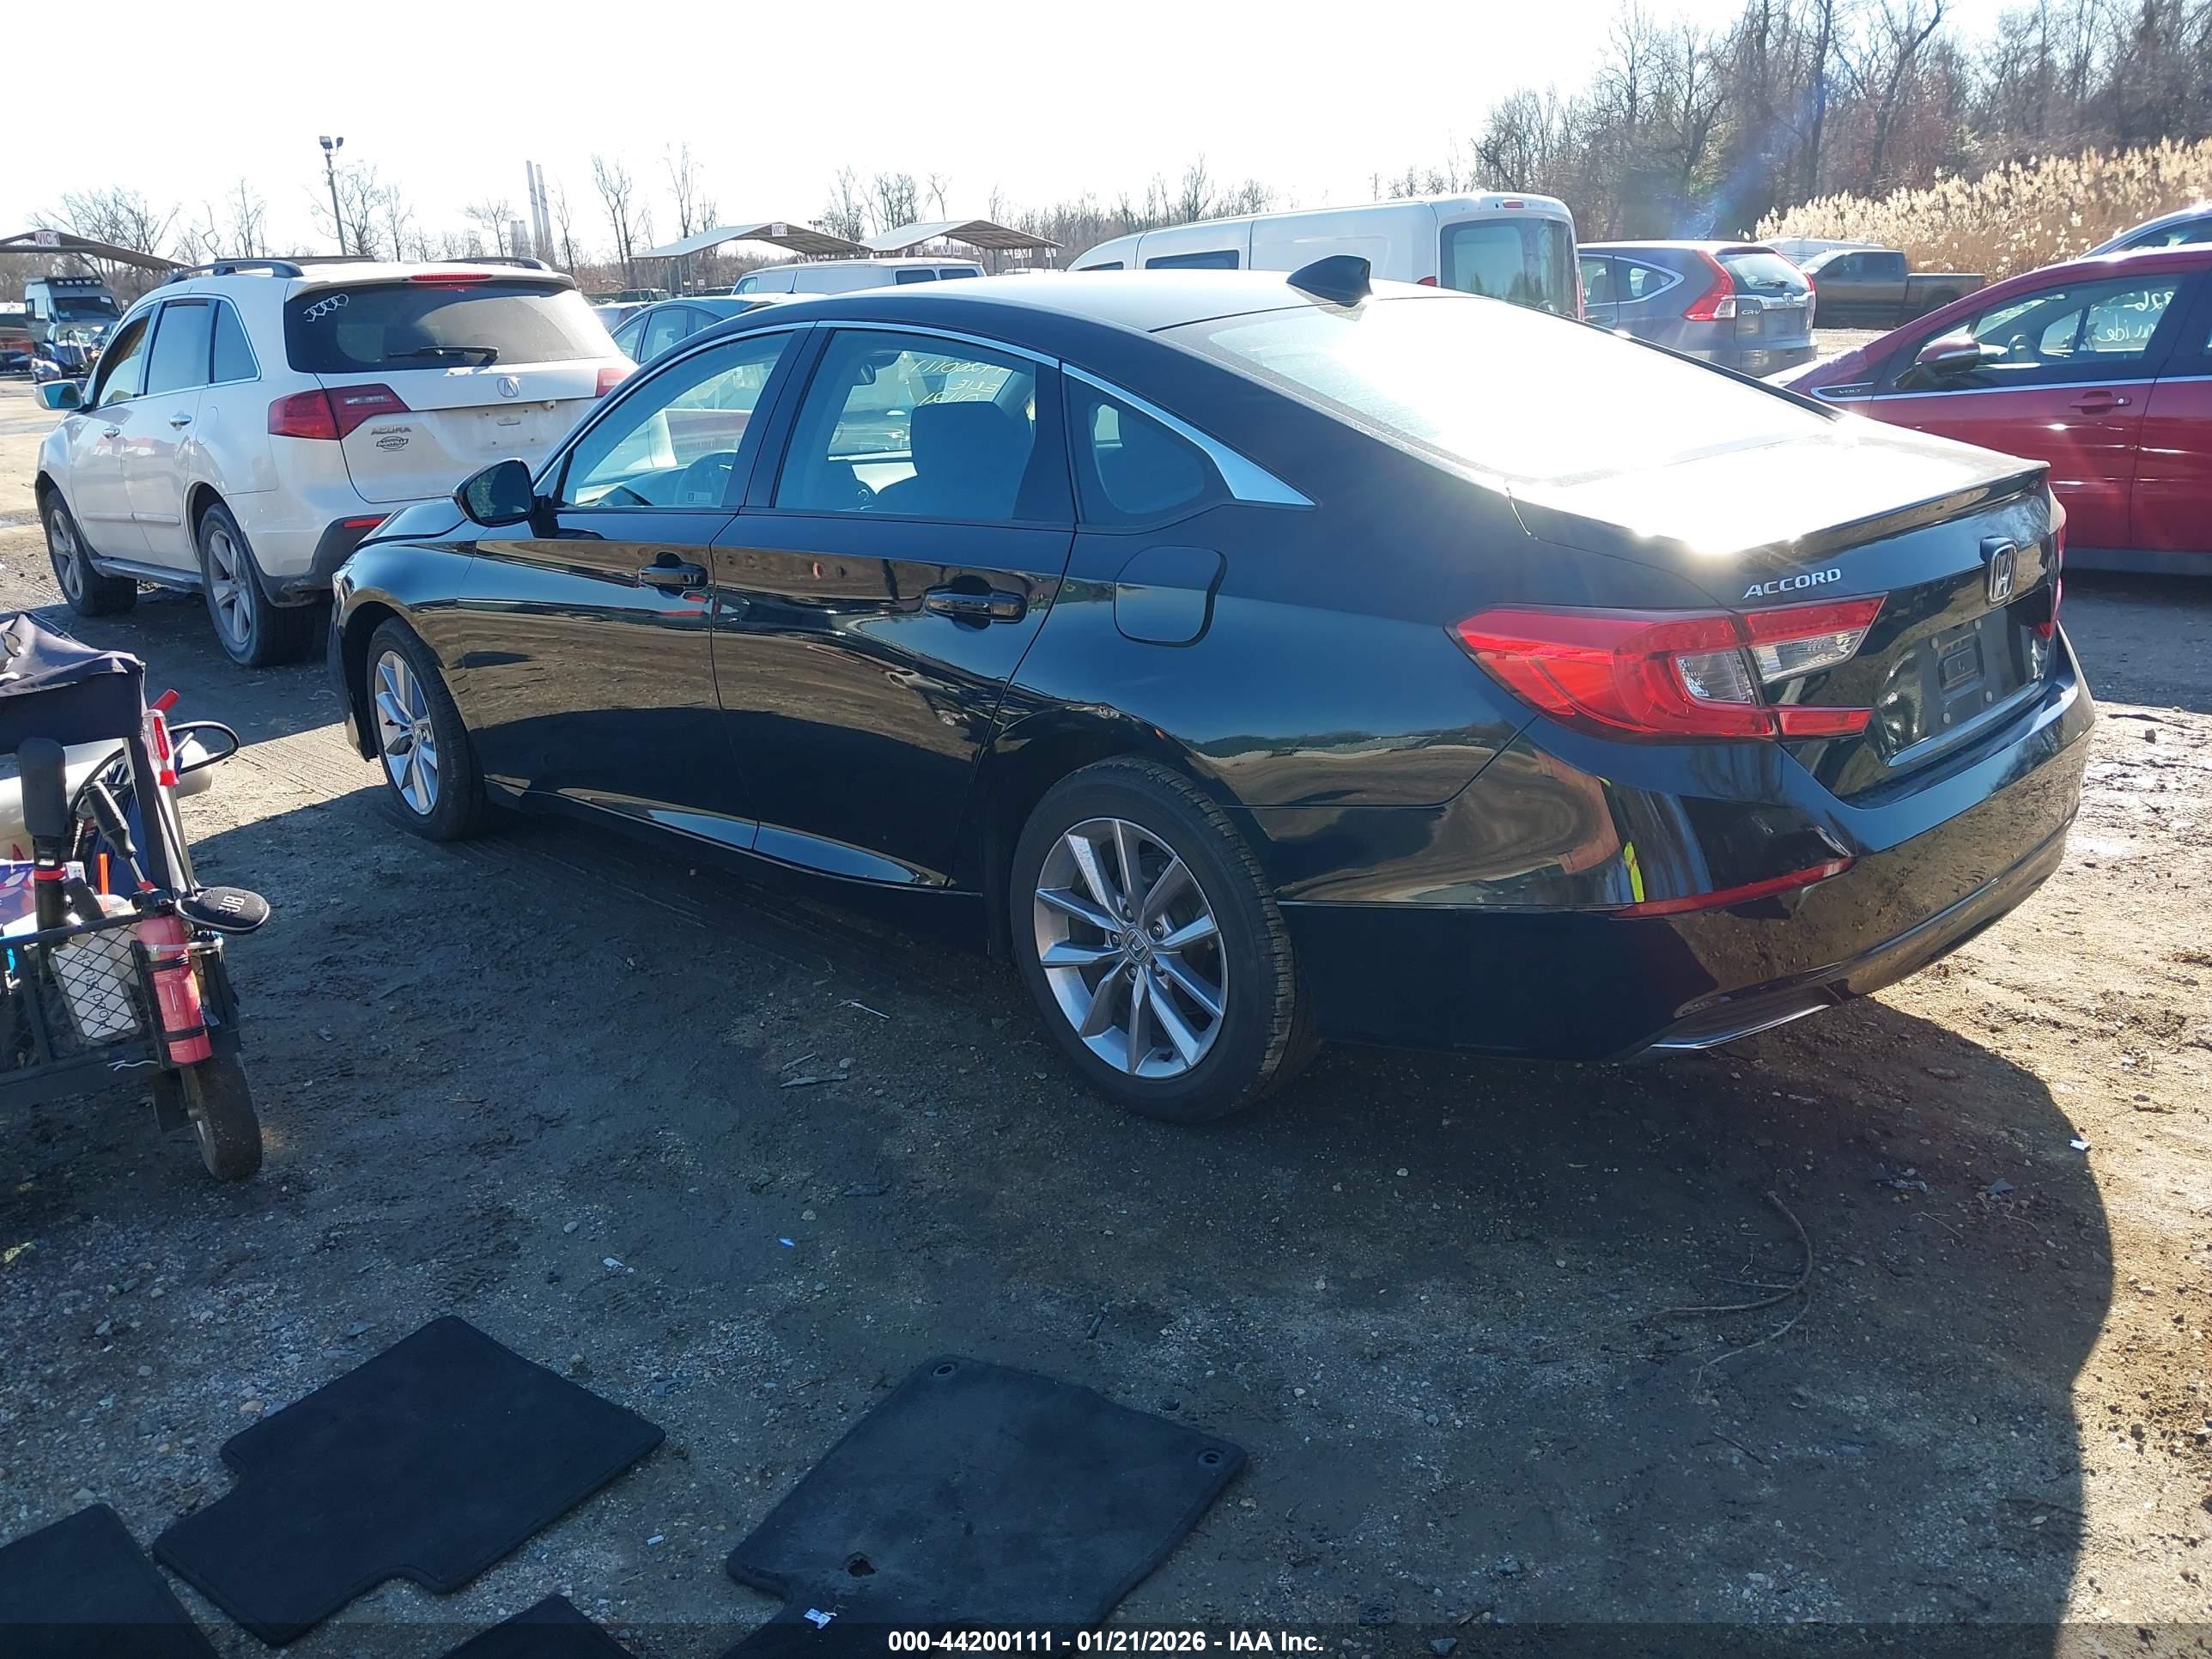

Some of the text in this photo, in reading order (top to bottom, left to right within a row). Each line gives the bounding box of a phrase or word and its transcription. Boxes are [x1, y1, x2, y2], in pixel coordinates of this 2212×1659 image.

[36, 233, 59, 246] VIC 1
[1741, 568, 1841, 599] ACCORD
